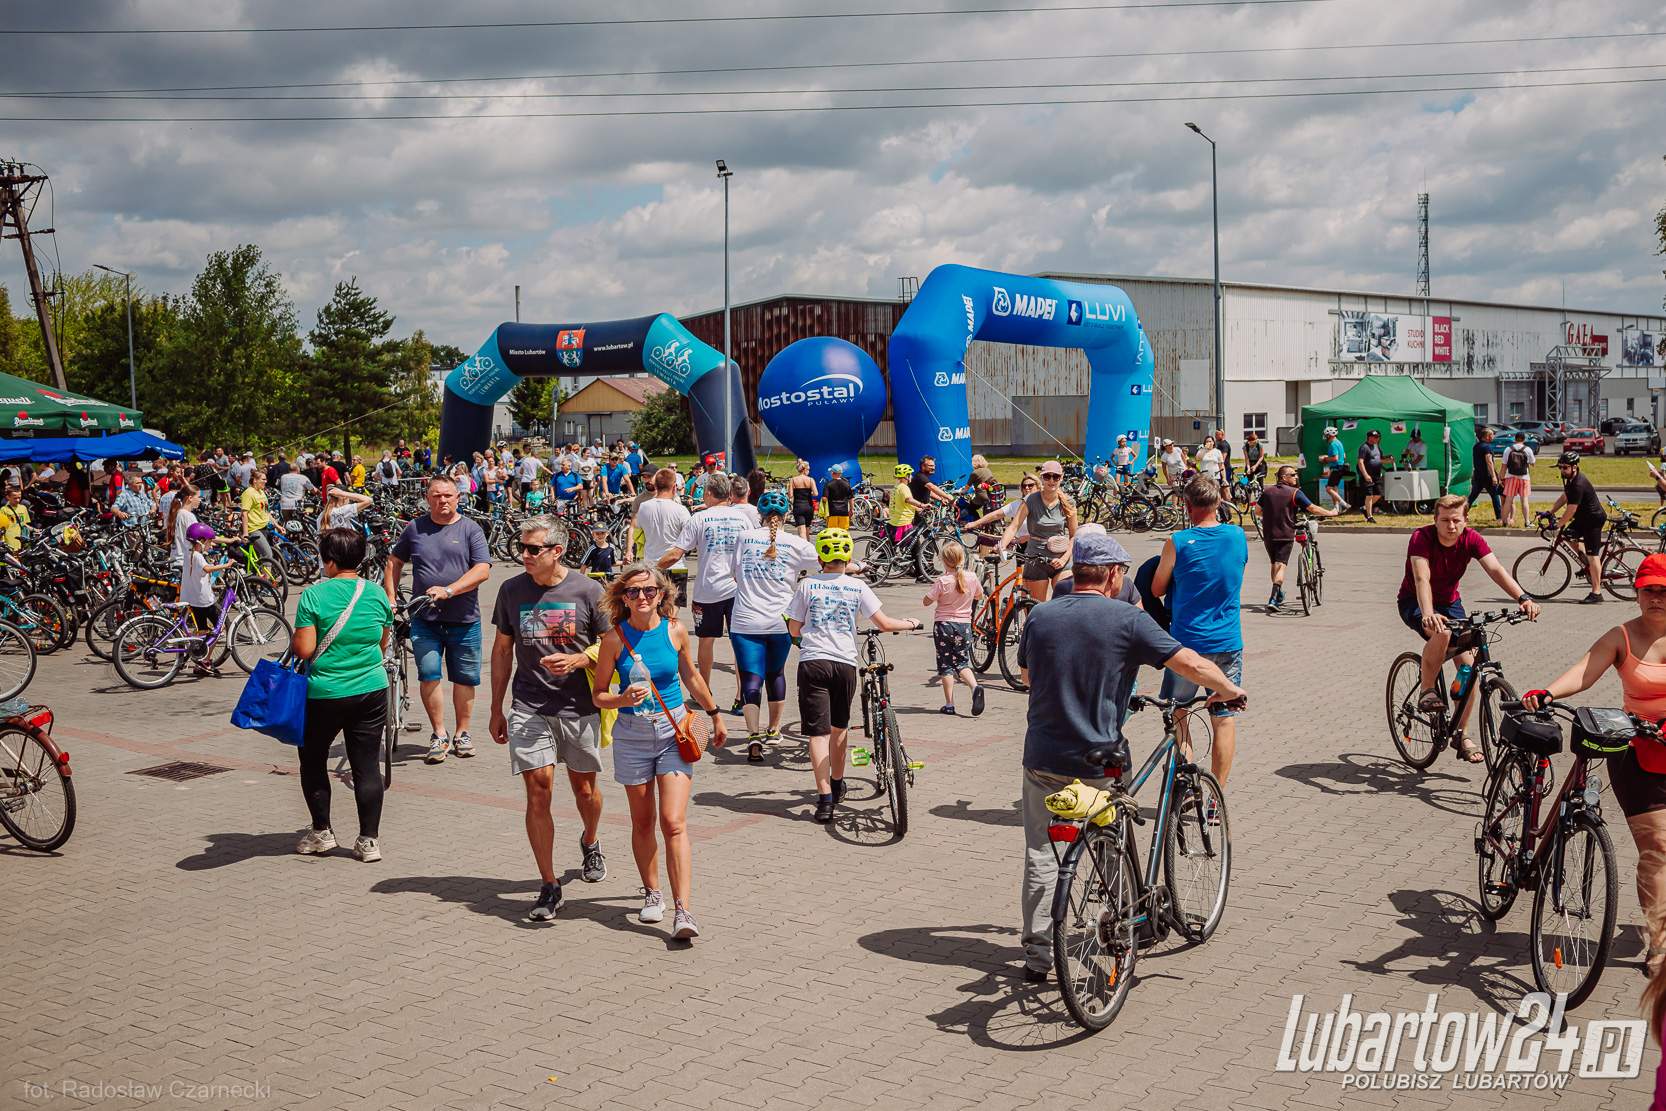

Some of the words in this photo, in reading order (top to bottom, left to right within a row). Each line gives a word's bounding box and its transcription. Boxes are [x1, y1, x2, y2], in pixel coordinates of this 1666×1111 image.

[1013, 293, 1058, 321] MAPEI
[1084, 301, 1126, 322] LUVI
[1434, 323, 1450, 333] BLACK
[1434, 335, 1445, 344] RED
[1434, 346, 1450, 356] WHITE
[951, 373, 966, 384] MA
[807, 397, 855, 407] PUŁAWY
[955, 426, 971, 439] MA
